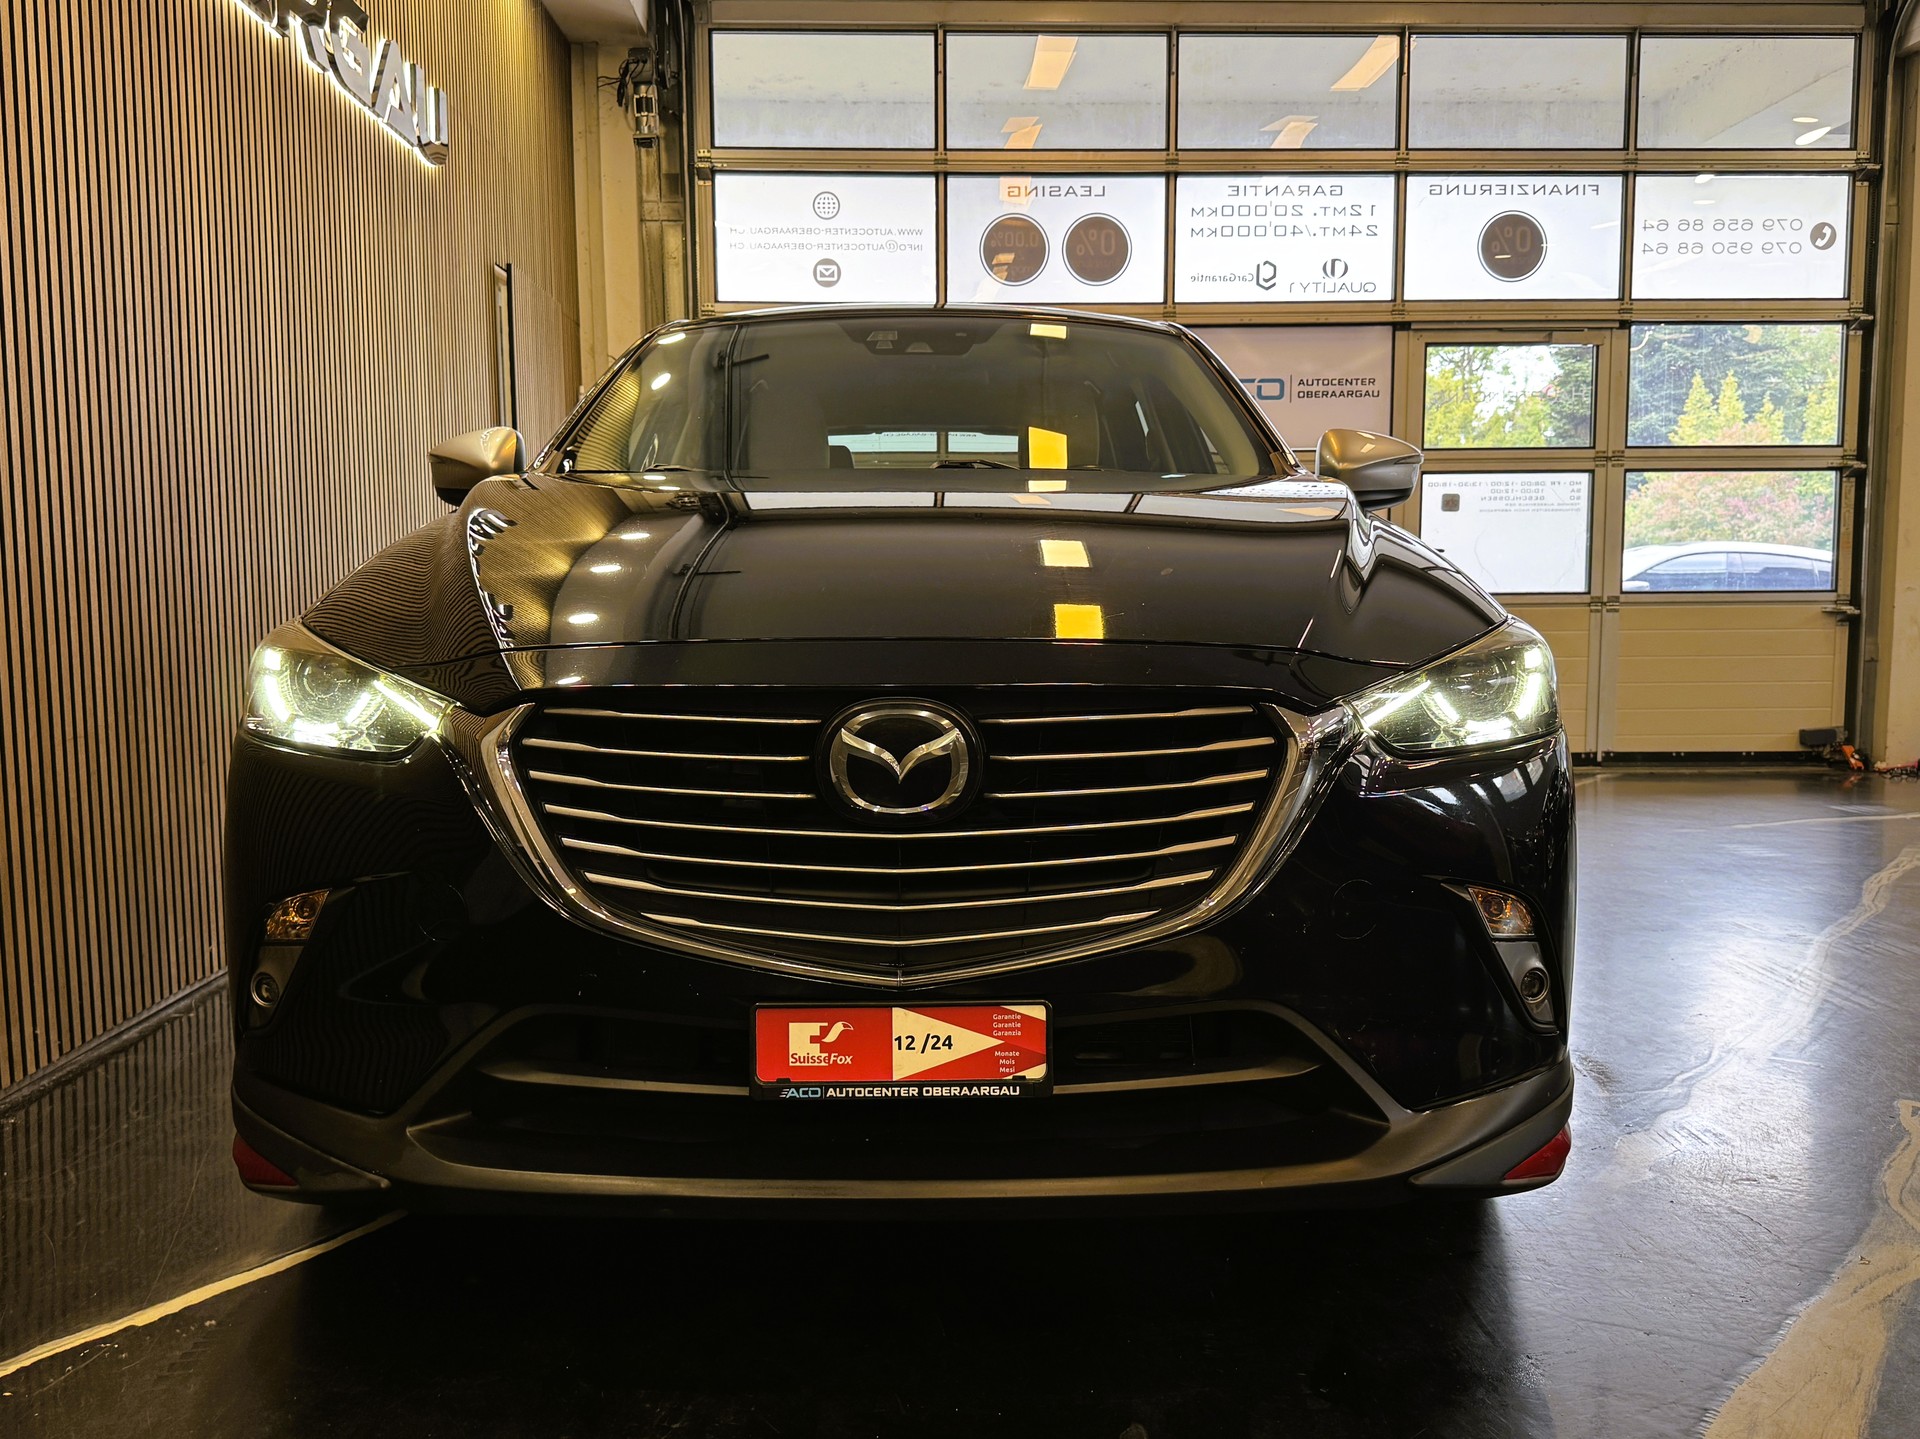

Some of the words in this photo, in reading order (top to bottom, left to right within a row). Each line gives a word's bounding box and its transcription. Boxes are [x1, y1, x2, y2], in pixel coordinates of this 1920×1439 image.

[1297, 377, 1376, 387] AUTOCENTER
[1297, 389, 1380, 399] OBERAARGAU
[993, 1013, 1022, 1021] Garantie
[993, 1021, 1022, 1029] Garantie
[993, 1029, 1022, 1037] Garanzia
[894, 1034, 916, 1051] 12
[994, 1050, 1020, 1058] Monate
[999, 1058, 1016, 1066] Mois
[999, 1066, 1016, 1074] Mesi
[826, 1086, 919, 1098] AUTOCENTER
[922, 1085, 1020, 1097] OBERAARGAU
